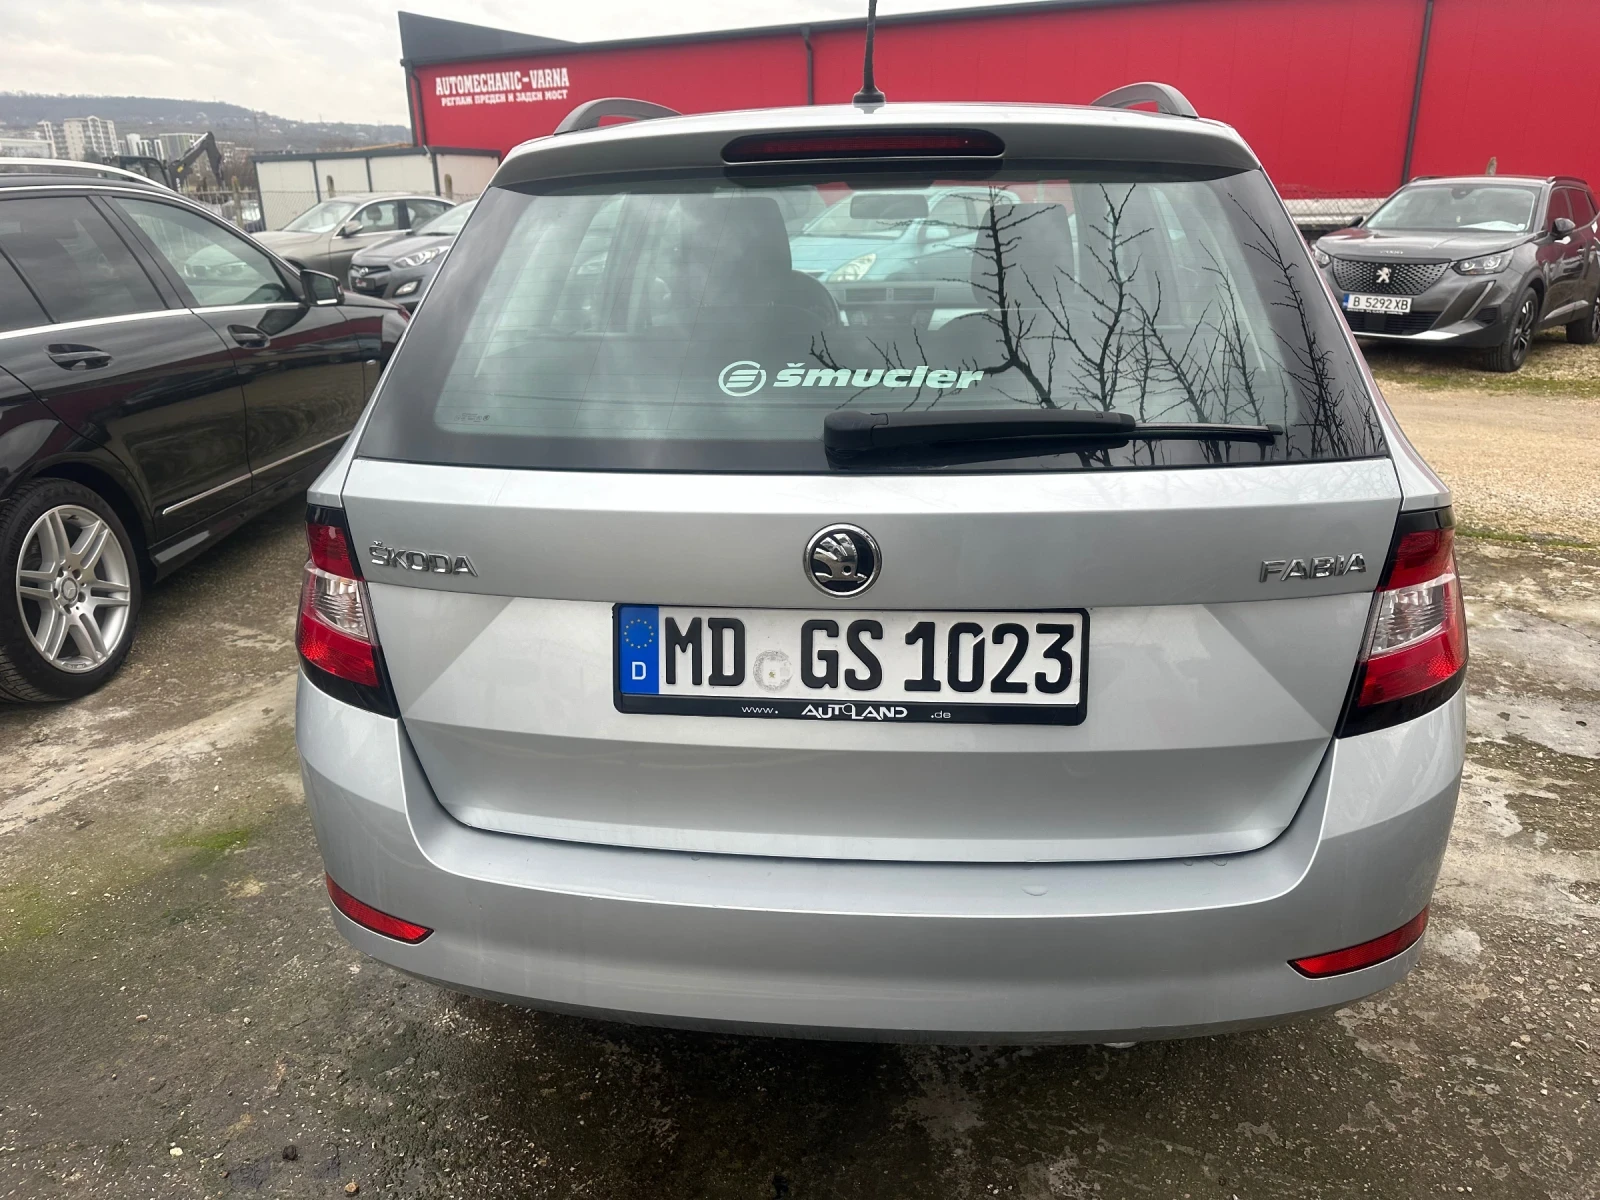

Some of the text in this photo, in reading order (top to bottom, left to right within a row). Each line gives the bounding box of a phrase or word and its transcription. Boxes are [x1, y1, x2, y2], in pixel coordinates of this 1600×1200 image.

[435, 67, 570, 96] AUTOMECHANIC-VARNA
[474, 94, 506, 105] ПРЕДЕН
[508, 93, 515, 103] И
[516, 92, 543, 103] ЗАДЕН
[545, 90, 568, 100] МОСТ
[1365, 297, 1392, 310] 5292
[773, 362, 985, 389] šmucler
[368, 540, 479, 578] ŠKODA
[1258, 552, 1367, 583] FABIA
[664, 616, 1075, 694] MD GS 1023
[631, 661, 647, 681] D
